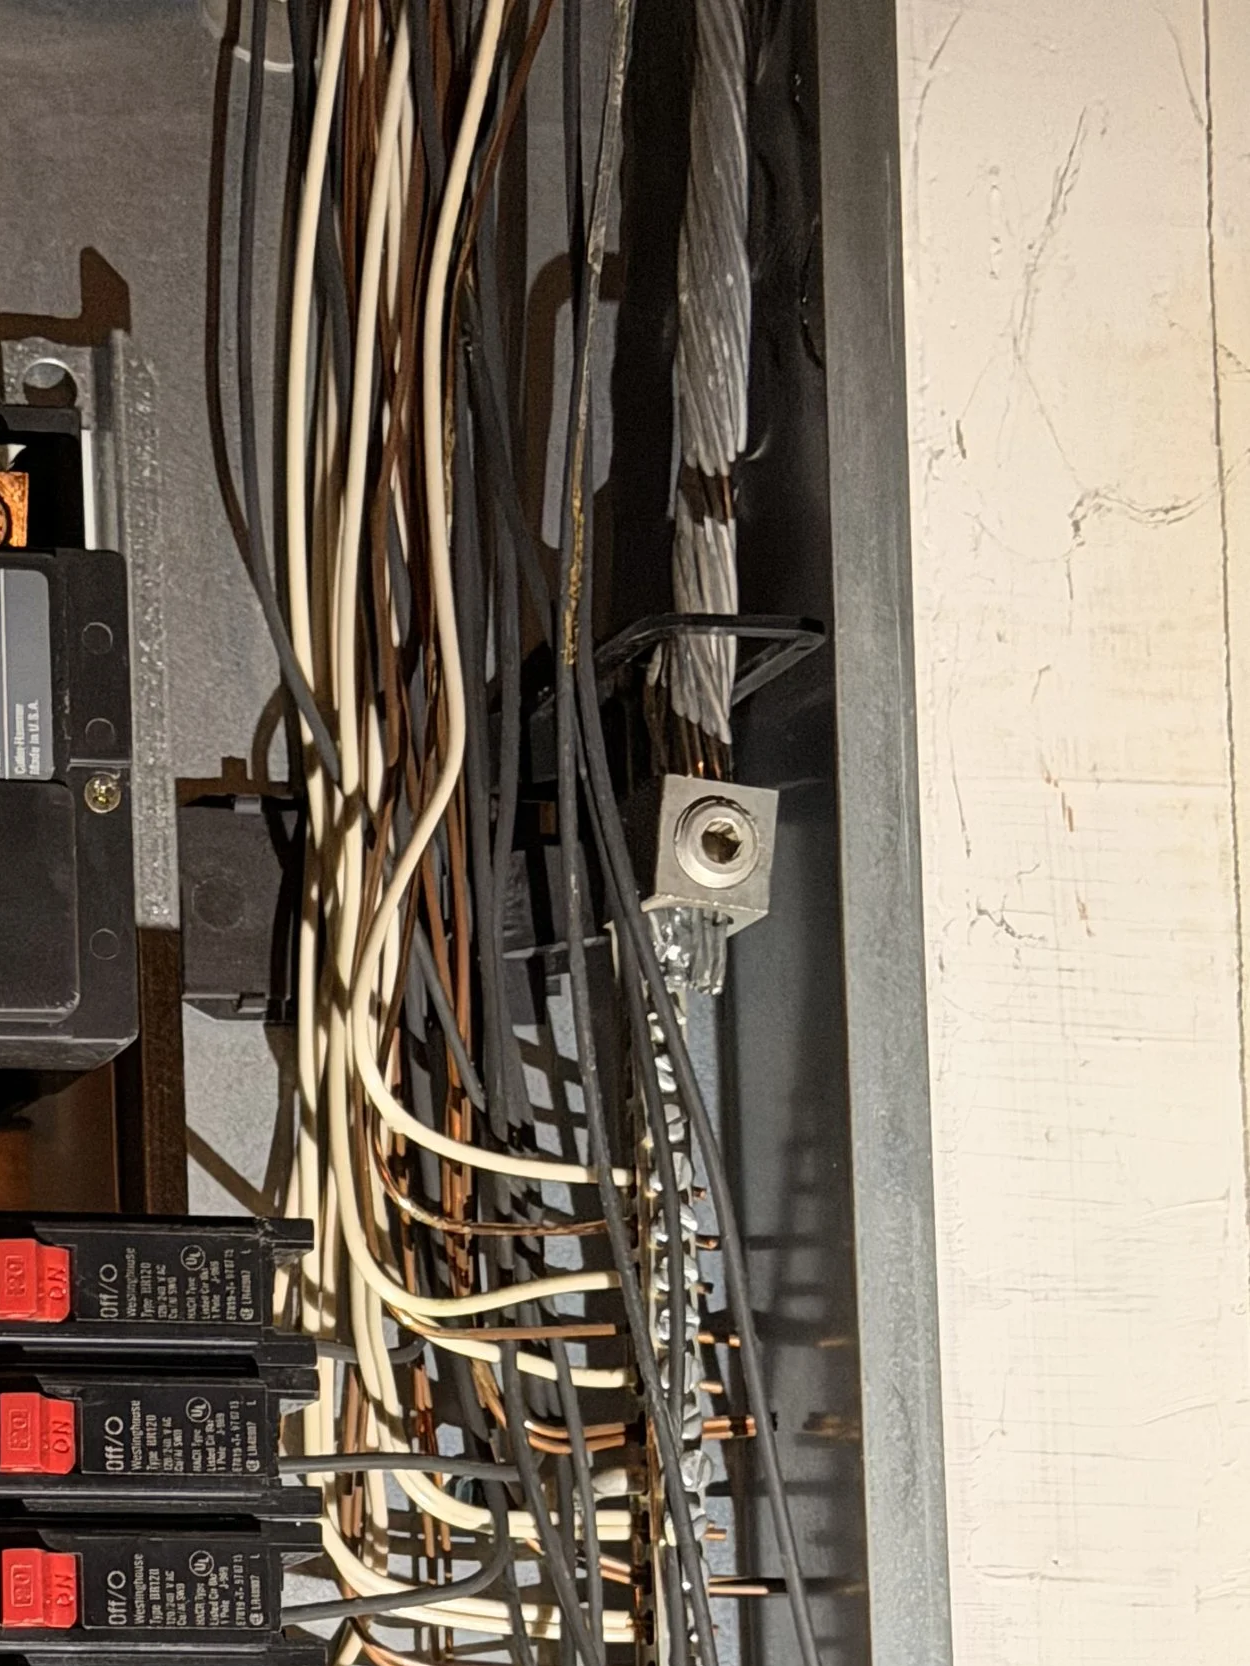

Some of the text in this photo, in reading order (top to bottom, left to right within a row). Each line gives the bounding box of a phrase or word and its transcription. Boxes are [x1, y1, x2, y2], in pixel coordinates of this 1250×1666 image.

[28, 700, 39, 731] U.S.A.
[15, 703, 26, 775] Cutler-Hammer
[29, 747, 41, 775] Made
[48, 1268, 66, 1300] ON
[124, 1247, 137, 1317] Westinghouse
[141, 1298, 154, 1318] Type
[53, 1420, 70, 1455] ON
[129, 1400, 144, 1470] Westinghouse
[146, 1451, 160, 1471] Type
[54, 1573, 72, 1607] ON
[132, 1554, 146, 1625] Westinghouse
[148, 1604, 162, 1625] Type
